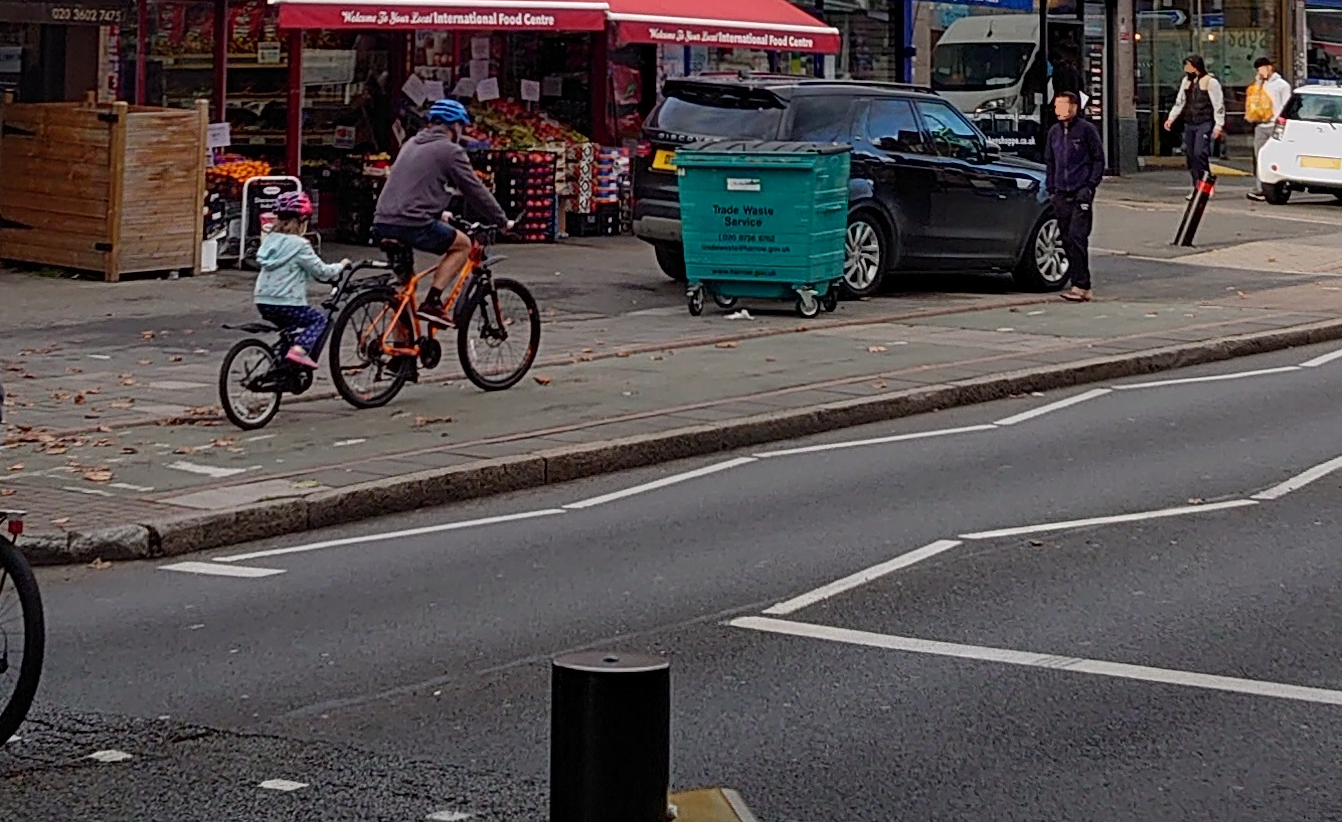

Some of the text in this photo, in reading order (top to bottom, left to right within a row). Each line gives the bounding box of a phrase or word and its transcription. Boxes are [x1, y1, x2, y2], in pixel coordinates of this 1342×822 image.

[51, 8, 121, 22] 020 3602 7475
[341, 10, 555, 26] Welcome To Your Local International Food Centre
[649, 28, 676, 40] Welcome
[676, 29, 685, 42] To
[685, 29, 701, 42] Your
[718, 31, 769, 45] International
[769, 34, 788, 47] Food
[789, 36, 814, 48] Centre
[713, 204, 774, 216] Trade Waste
[724, 216, 762, 227] Service
